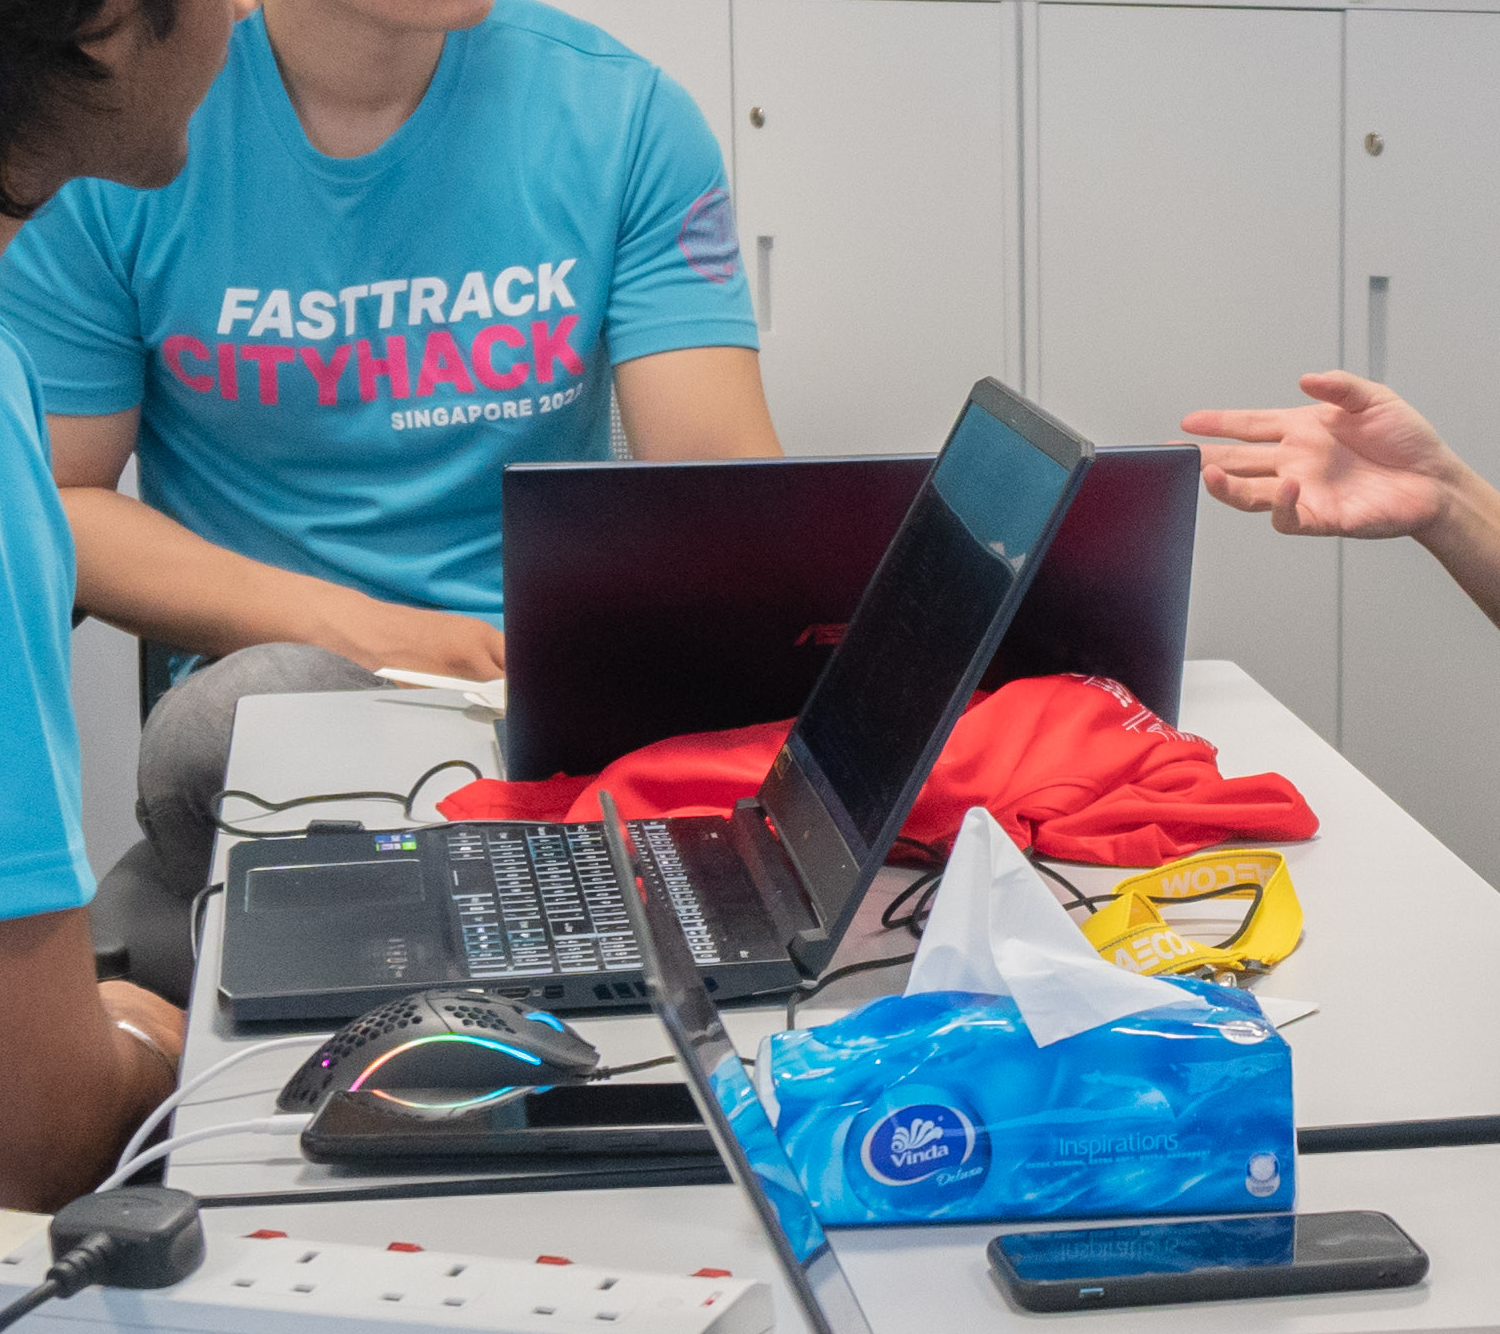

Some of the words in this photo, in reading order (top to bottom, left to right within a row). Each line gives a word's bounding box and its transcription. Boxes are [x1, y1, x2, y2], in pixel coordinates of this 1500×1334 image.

[216, 258, 577, 341] FASTTRACK
[162, 314, 586, 407] CITYHACK
[390, 398, 533, 431] SINGAPORE
[890, 1143, 949, 1168] Vinda
[1058, 1132, 1180, 1164] Inspirations
